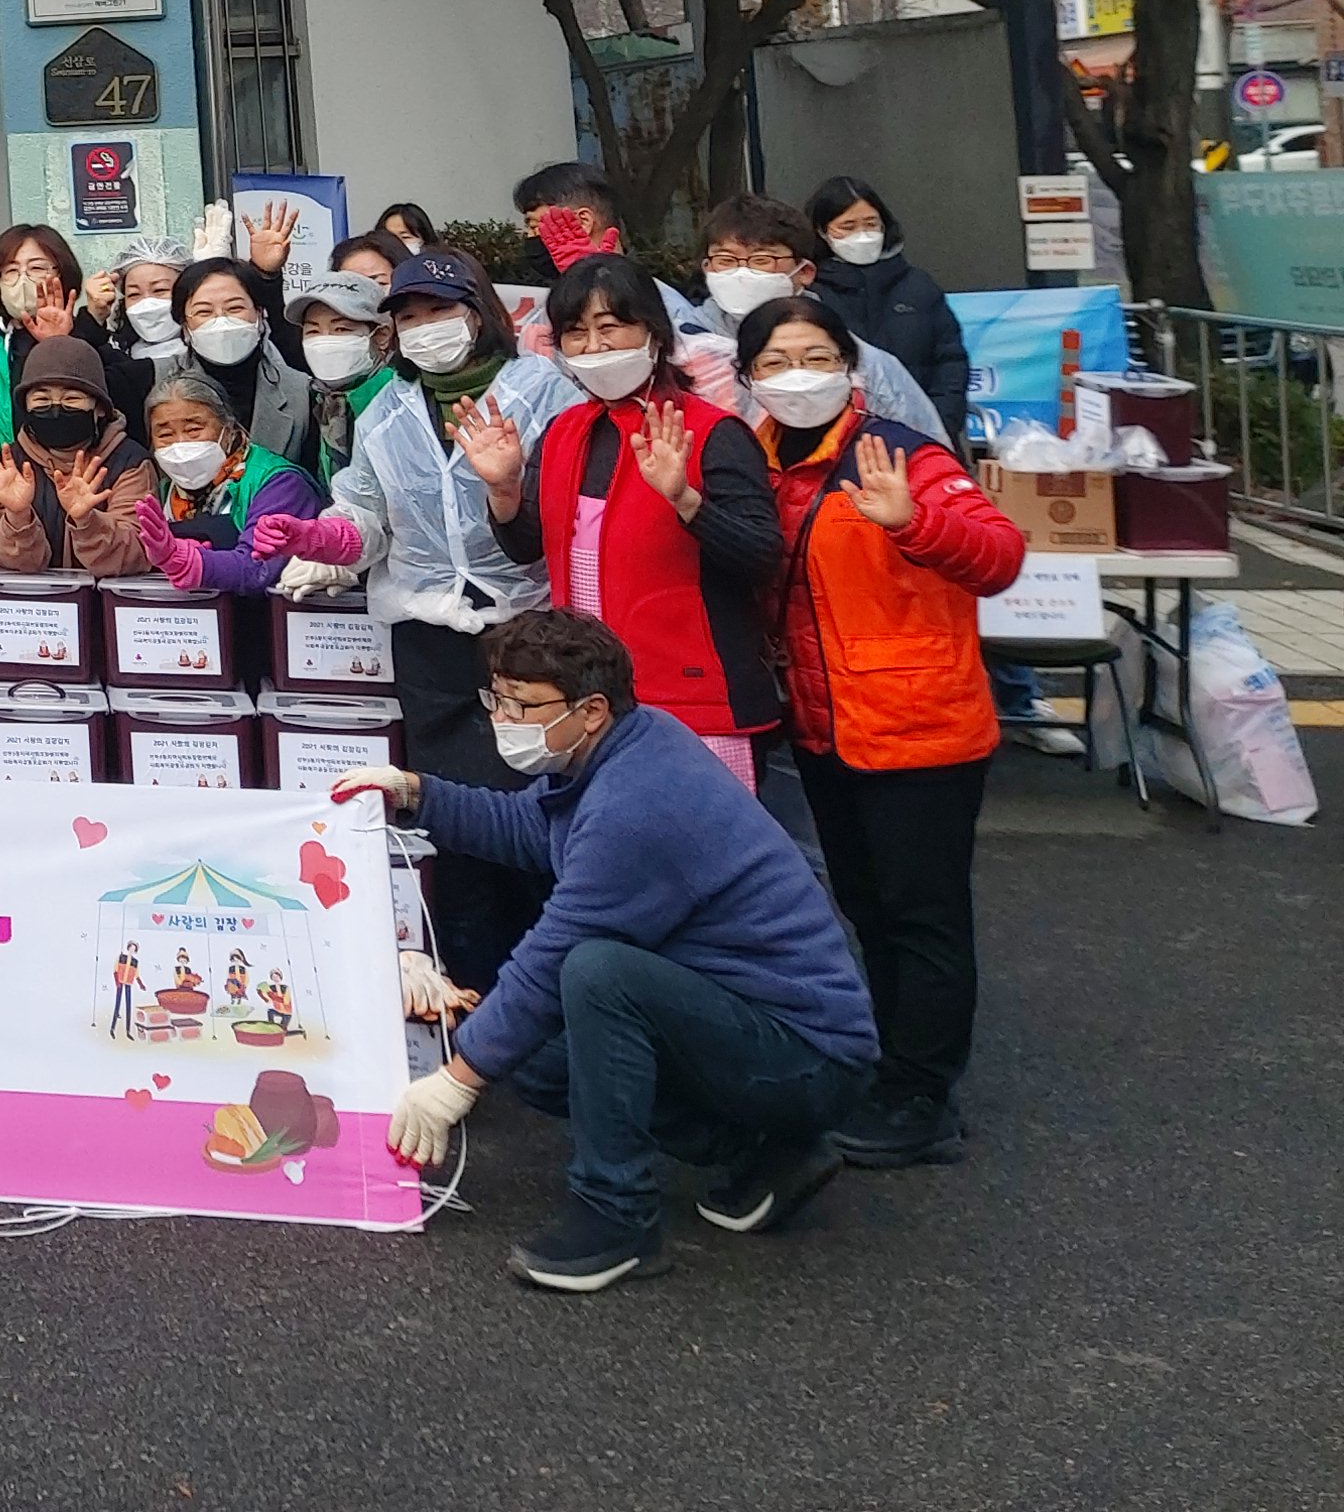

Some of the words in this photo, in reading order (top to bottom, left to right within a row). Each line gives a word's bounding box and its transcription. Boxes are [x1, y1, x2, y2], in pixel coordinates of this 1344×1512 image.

[94, 74, 152, 116] 47
[168, 914, 207, 931] 사랑의
[214, 916, 238, 932] 김장
